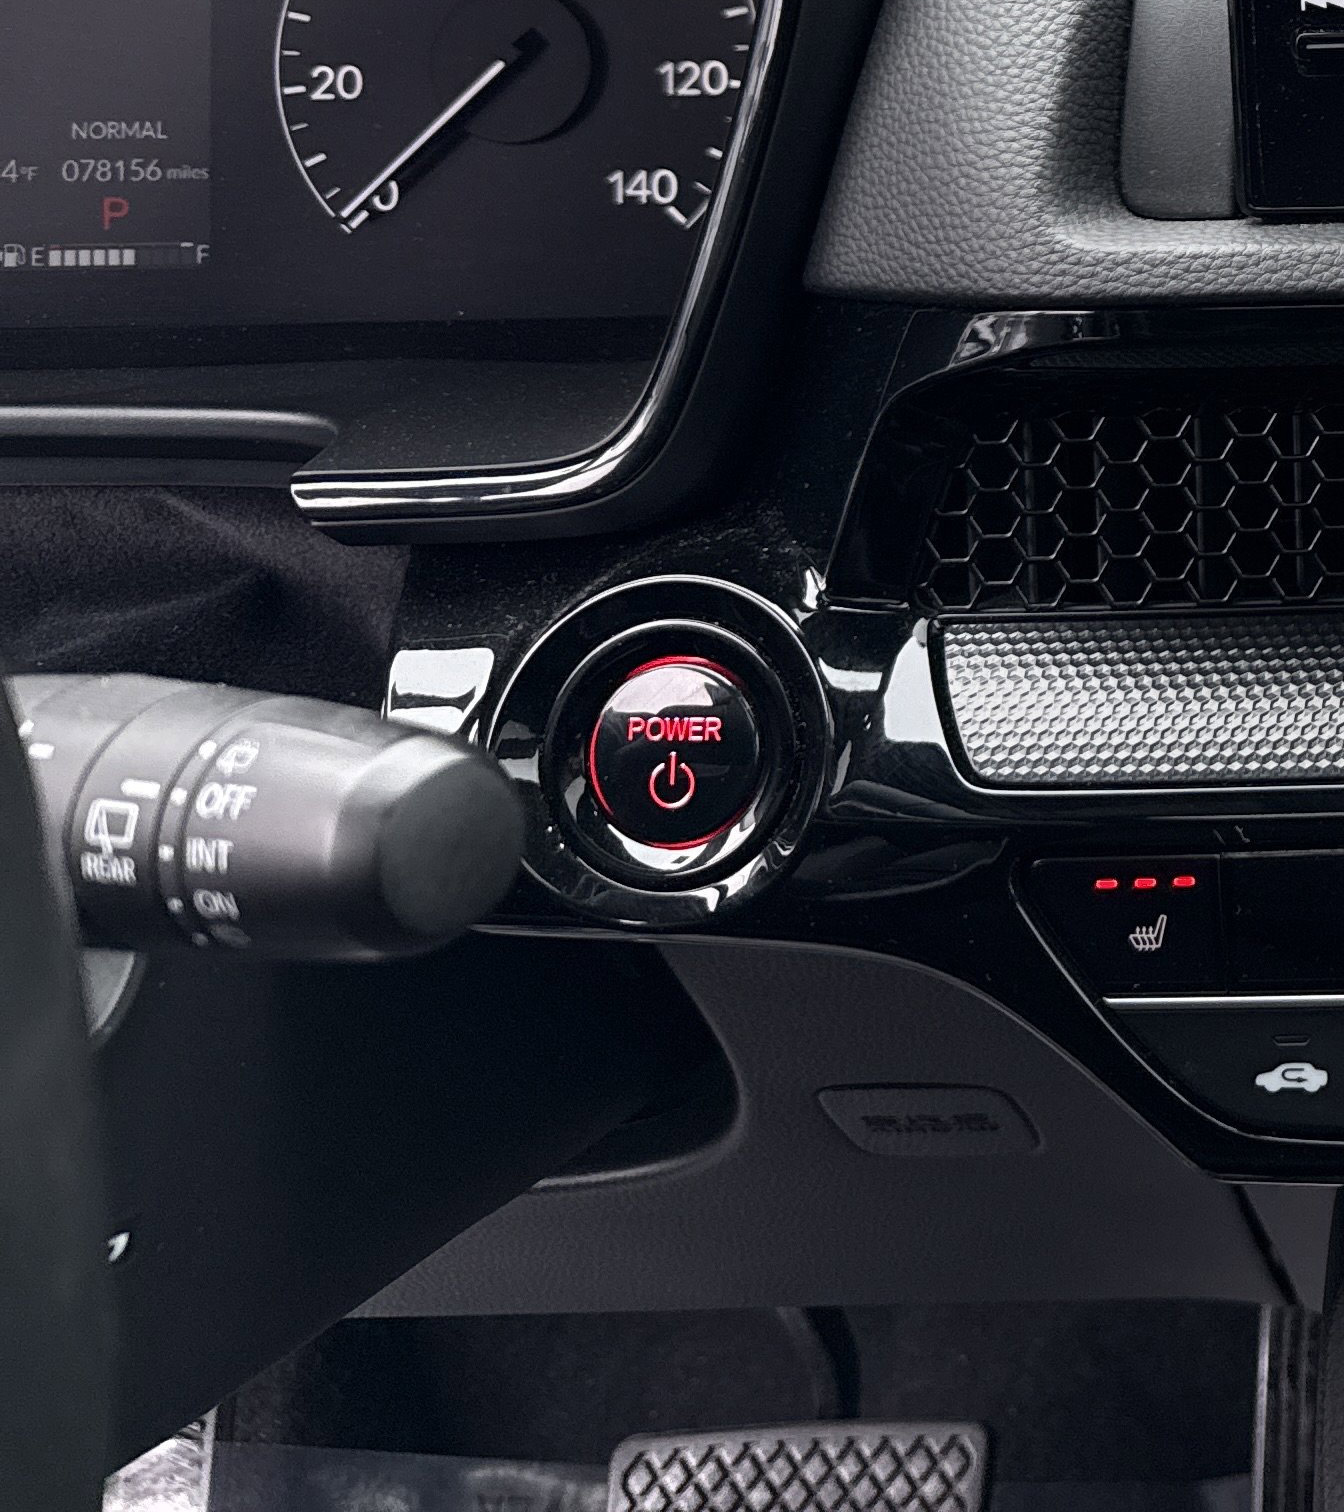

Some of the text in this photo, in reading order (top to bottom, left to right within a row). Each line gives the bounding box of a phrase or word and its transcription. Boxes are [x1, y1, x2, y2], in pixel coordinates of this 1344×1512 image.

[310, 64, 363, 100] 20
[656, 62, 731, 96] 120
[71, 120, 168, 139] NORMAL
[61, 158, 210, 182] 078156 miles
[606, 168, 679, 205] 140
[102, 196, 130, 230] P
[31, 246, 45, 267] E
[195, 244, 211, 265] F
[627, 716, 722, 743] POWER
[195, 781, 258, 820] OFF
[80, 851, 137, 886] REAR
[185, 837, 235, 875] INT
[193, 888, 240, 920] ON
